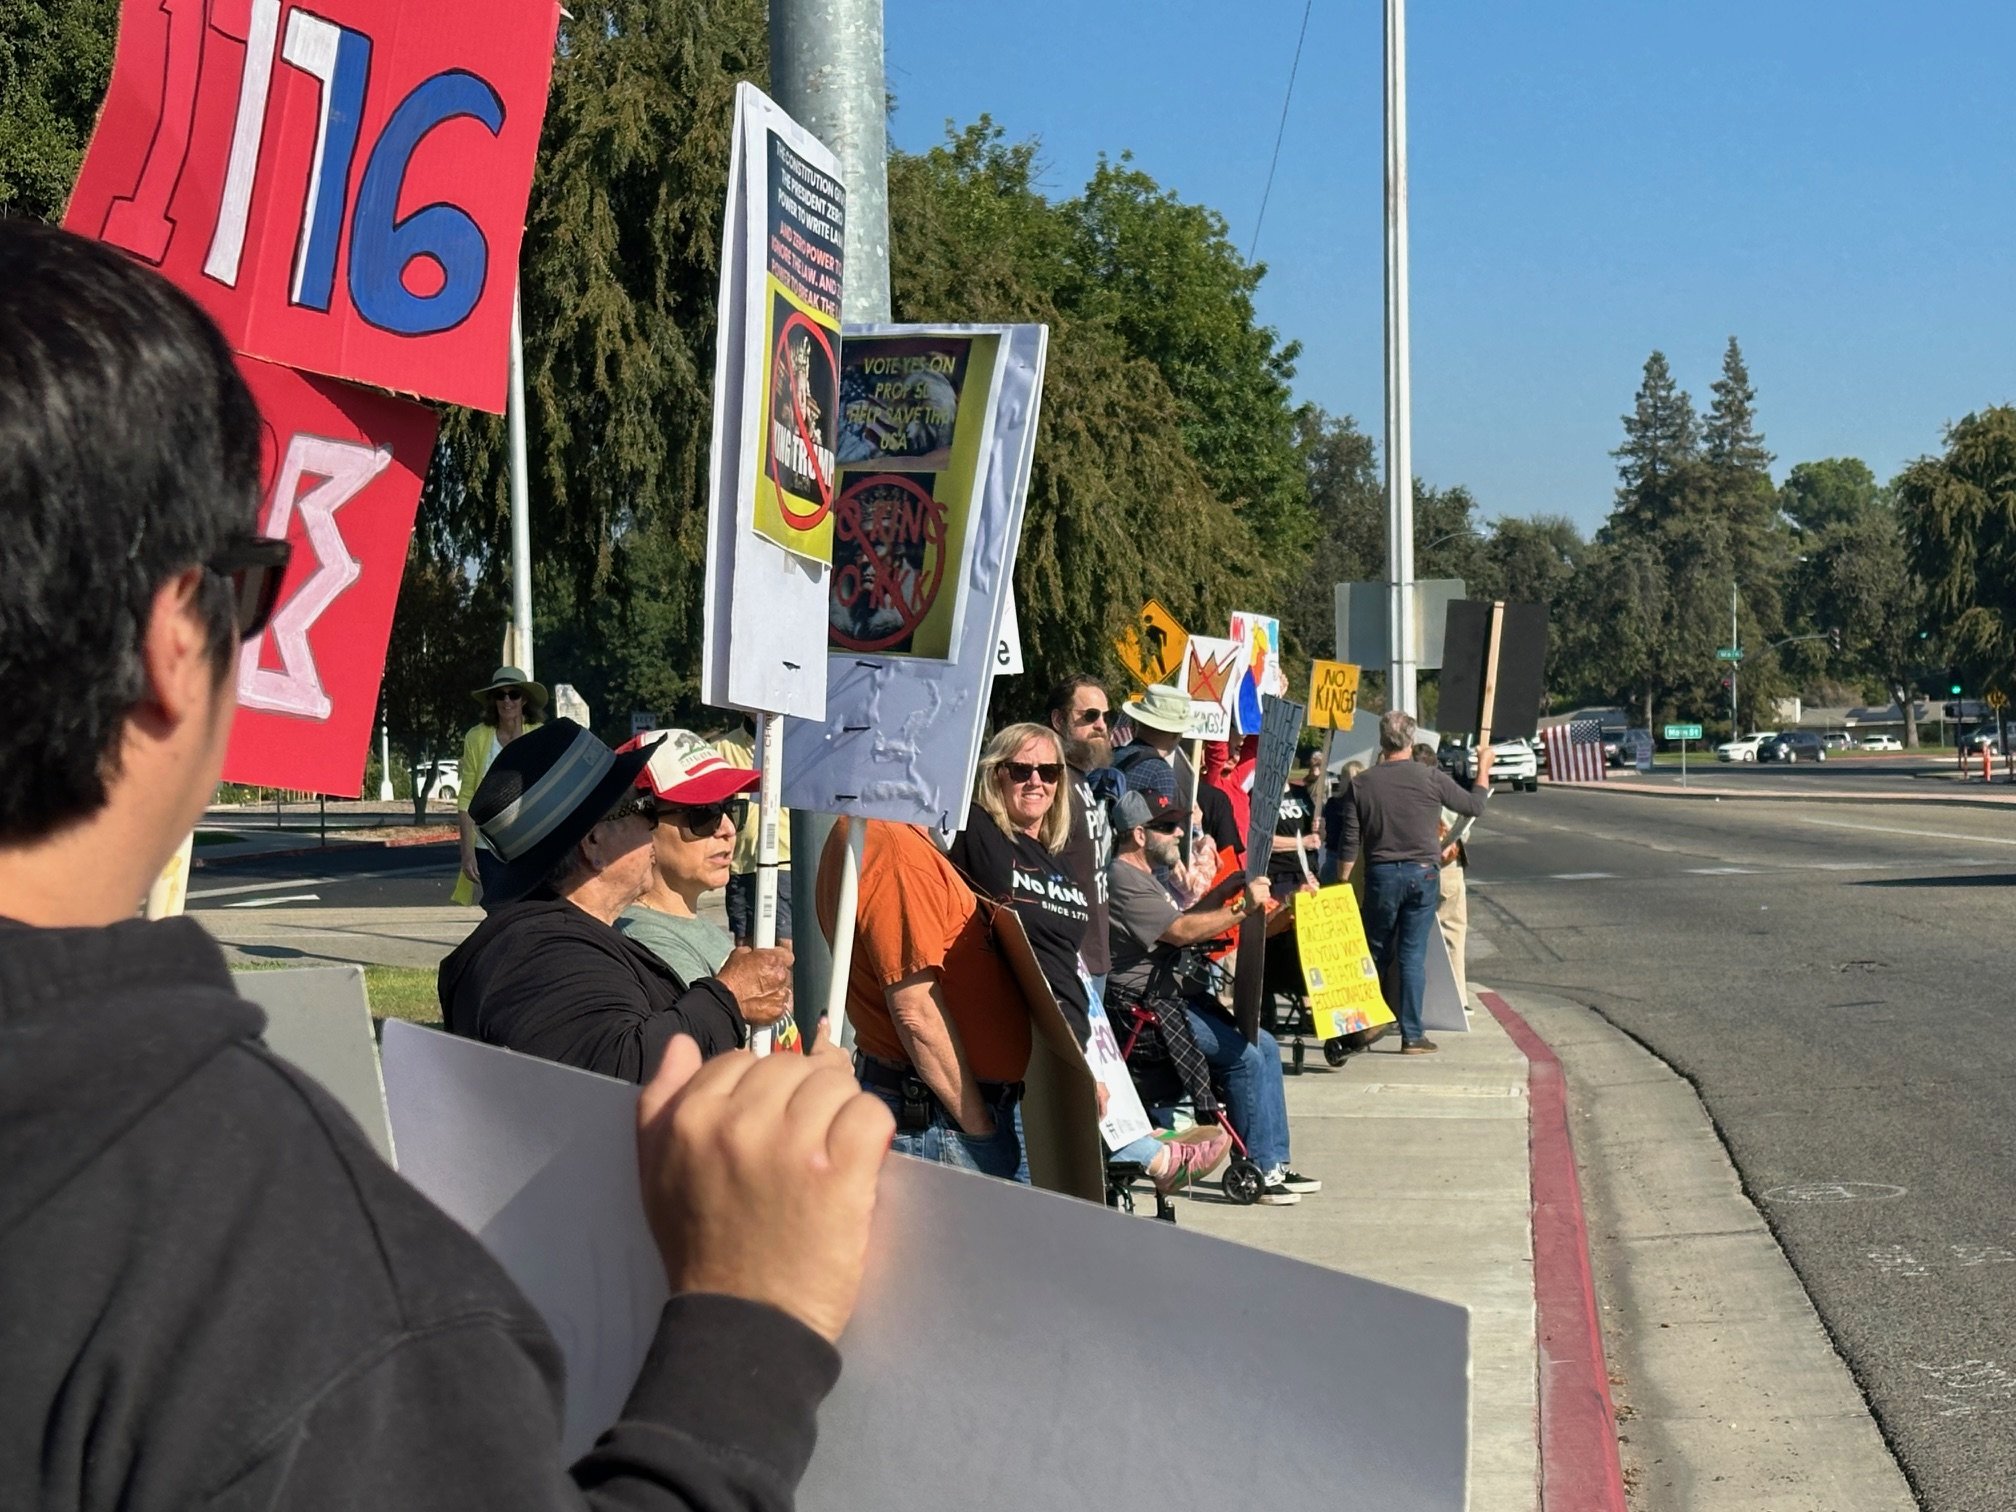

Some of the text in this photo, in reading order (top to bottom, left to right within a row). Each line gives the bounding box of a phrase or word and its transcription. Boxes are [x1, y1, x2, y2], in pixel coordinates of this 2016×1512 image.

[785, 151, 834, 198] CONSTITUTION
[778, 188, 797, 219] POWER
[797, 205, 806, 224] TO
[806, 211, 830, 240] WRITE
[781, 168, 843, 226] THE PRESIDENT ZERO
[780, 220, 793, 242] AND
[793, 230, 806, 254] ZERO
[806, 243, 834, 271] POWER
[771, 235, 791, 265] IGNORE
[792, 252, 801, 275] THE
[819, 274, 836, 295] AND
[771, 258, 790, 287] POWER
[798, 282, 819, 309] BREAK
[820, 296, 835, 316] THE
[864, 356, 956, 375] VOTE YES ON
[875, 382, 911, 400] PROP
[888, 406, 921, 425] SAVE
[1324, 668, 1345, 687] NO
[1315, 684, 1356, 713] KINGS
[1041, 900, 1069, 917] SINCE
